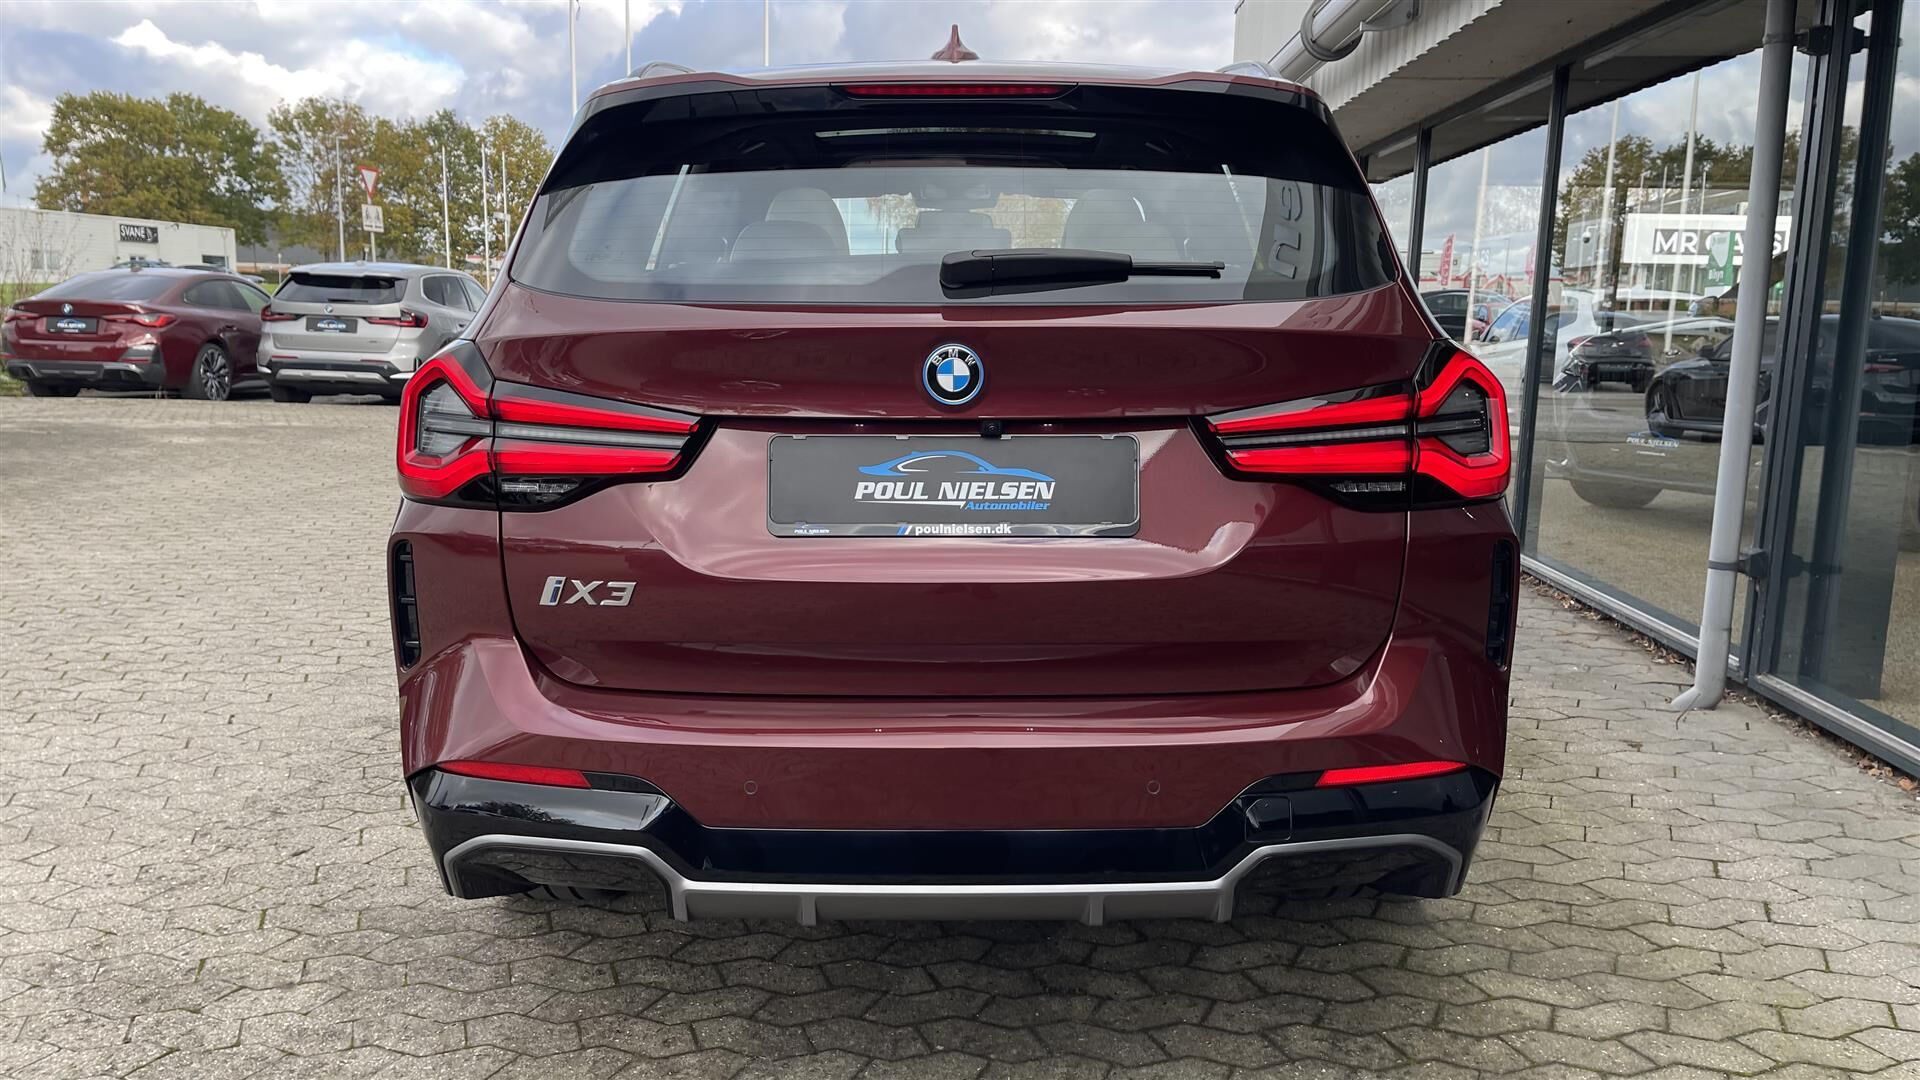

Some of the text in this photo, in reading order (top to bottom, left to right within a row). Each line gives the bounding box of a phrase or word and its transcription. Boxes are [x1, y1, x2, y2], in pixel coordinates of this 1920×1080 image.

[120, 225, 145, 239] SVANE
[1654, 231, 1698, 254] MR
[1705, 231, 1783, 257] AS
[931, 348, 976, 367] BMW
[855, 481, 1056, 500] POUL NIELSEN
[964, 501, 1051, 511] Automobiler
[915, 524, 1012, 536] poulnielsen.dk
[539, 576, 637, 606] iX3
